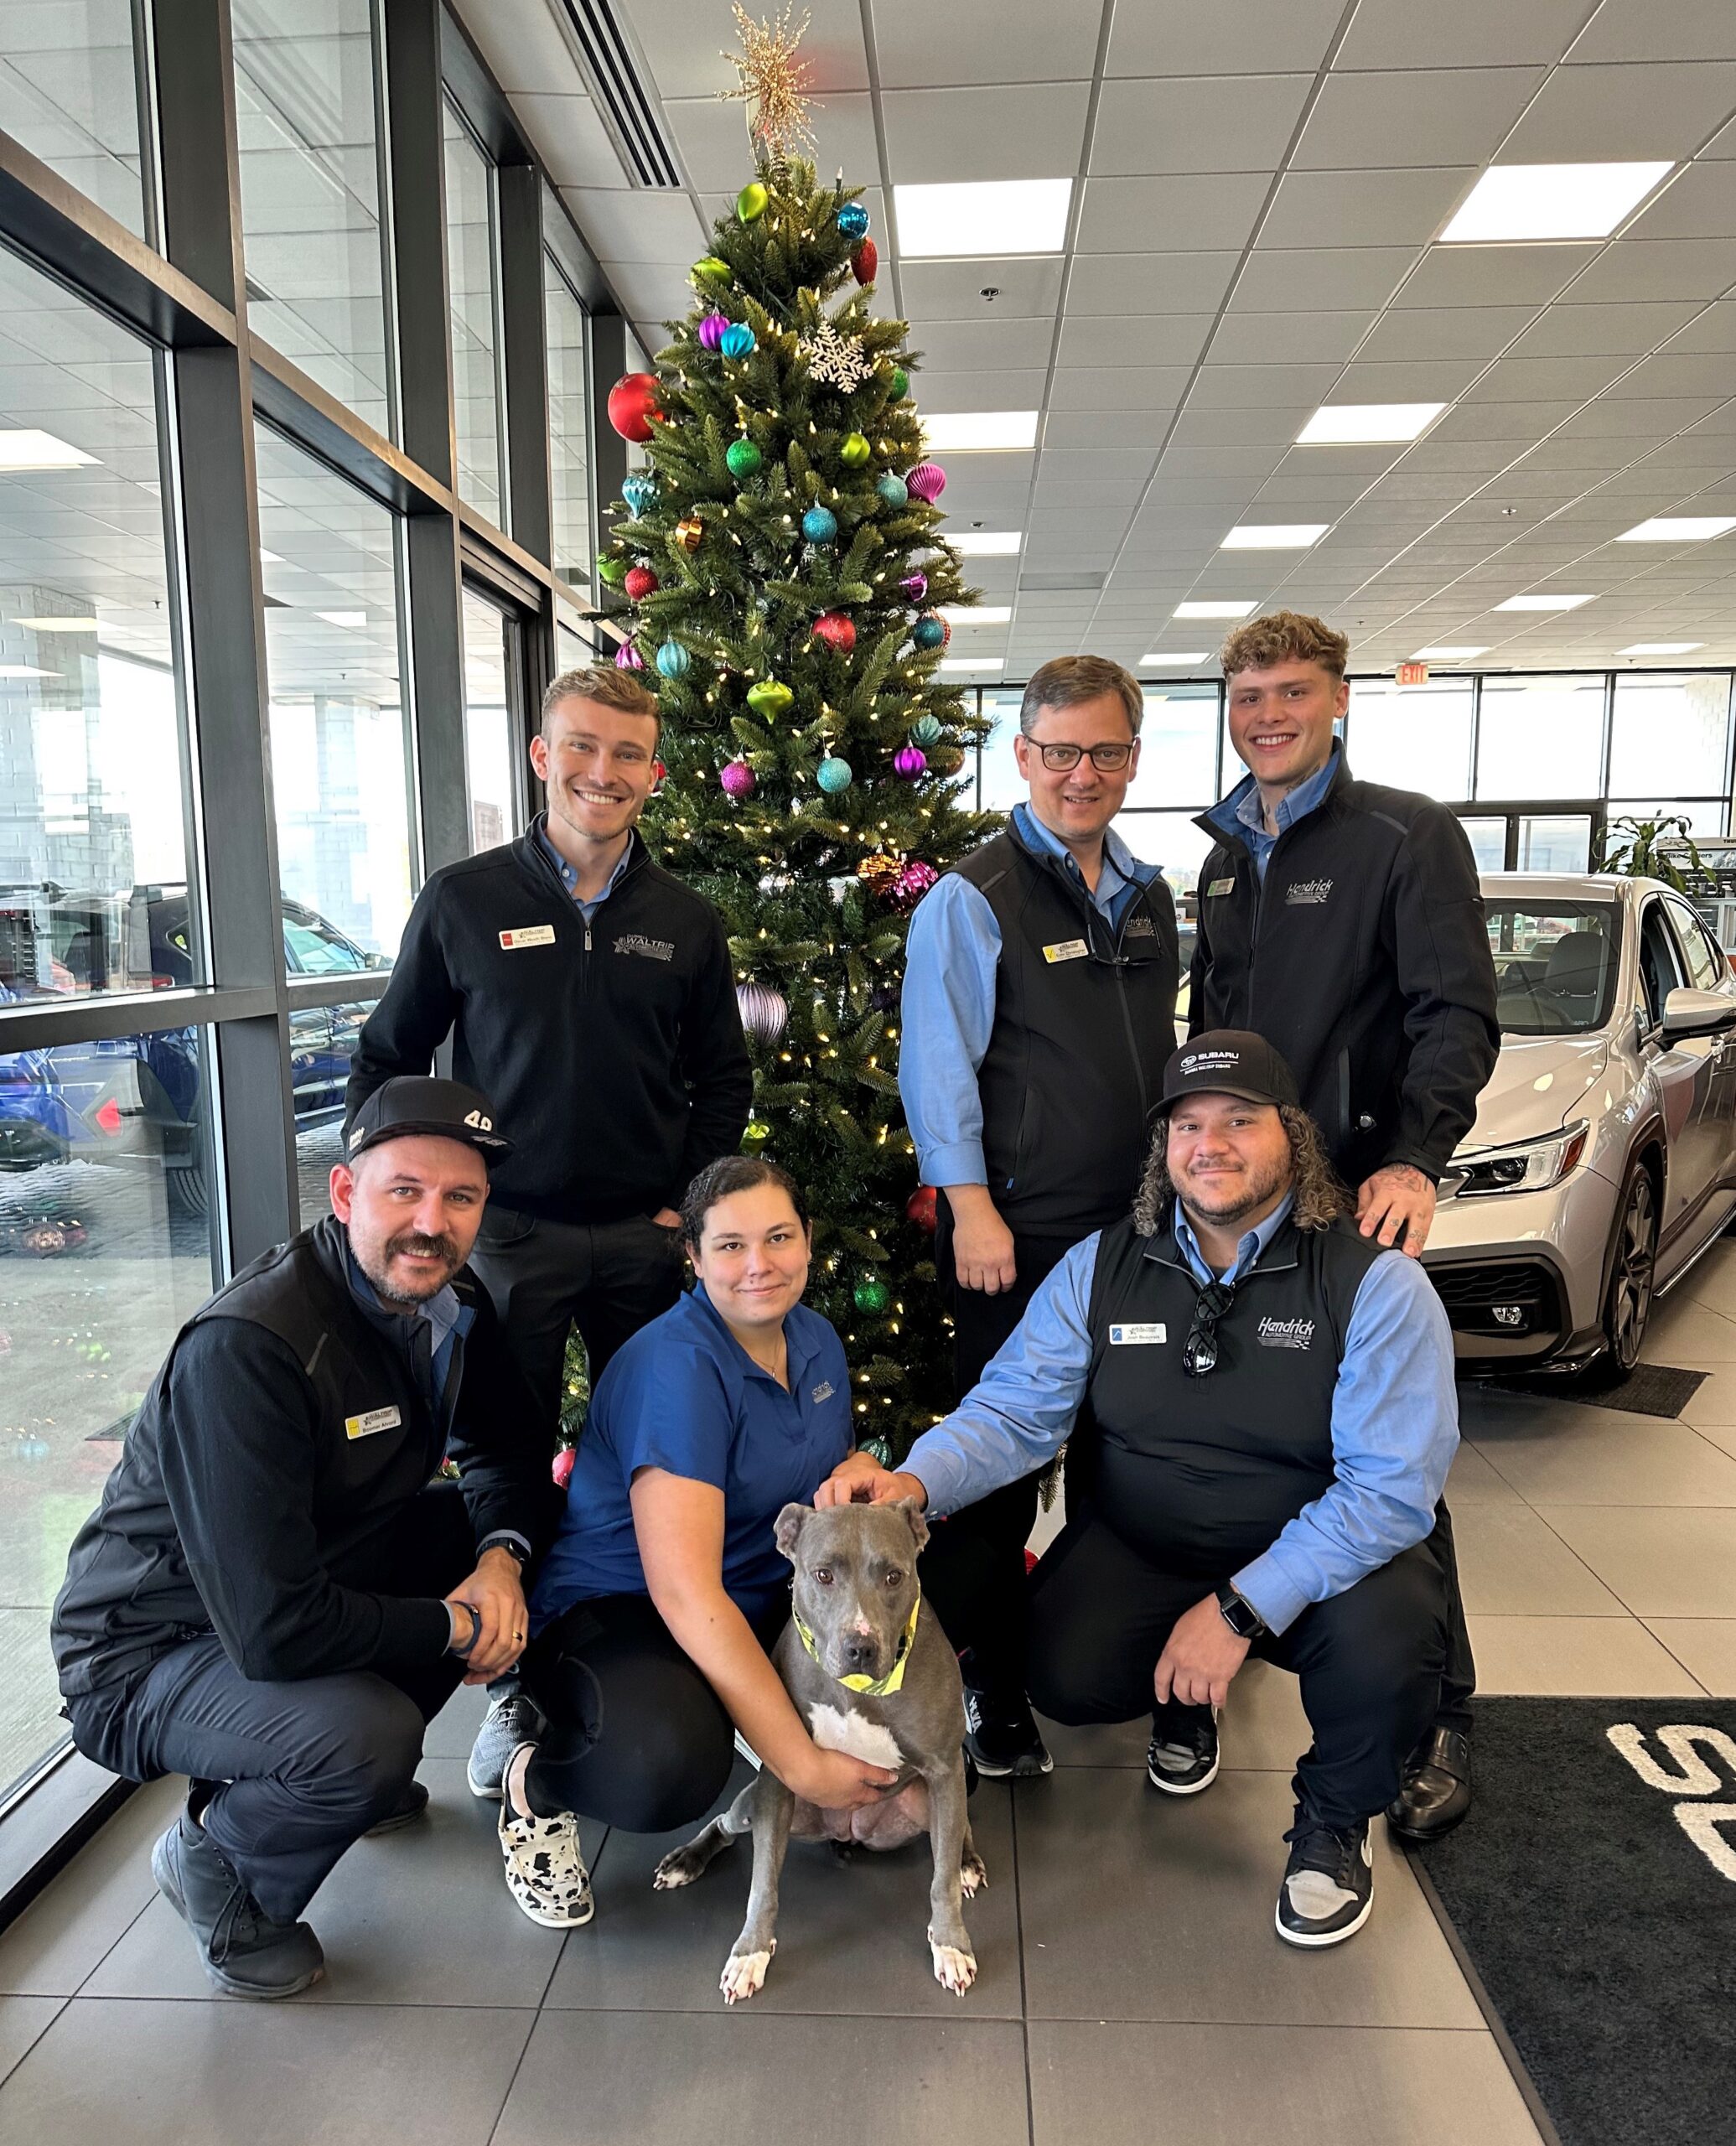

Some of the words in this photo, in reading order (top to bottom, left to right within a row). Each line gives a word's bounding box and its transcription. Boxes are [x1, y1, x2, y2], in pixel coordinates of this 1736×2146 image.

[1402, 666, 1427, 684] EXIT
[1287, 879, 1333, 896] Hendrick
[627, 936, 675, 950] WALTRIP
[1257, 1317, 1315, 1336] Hendrick
